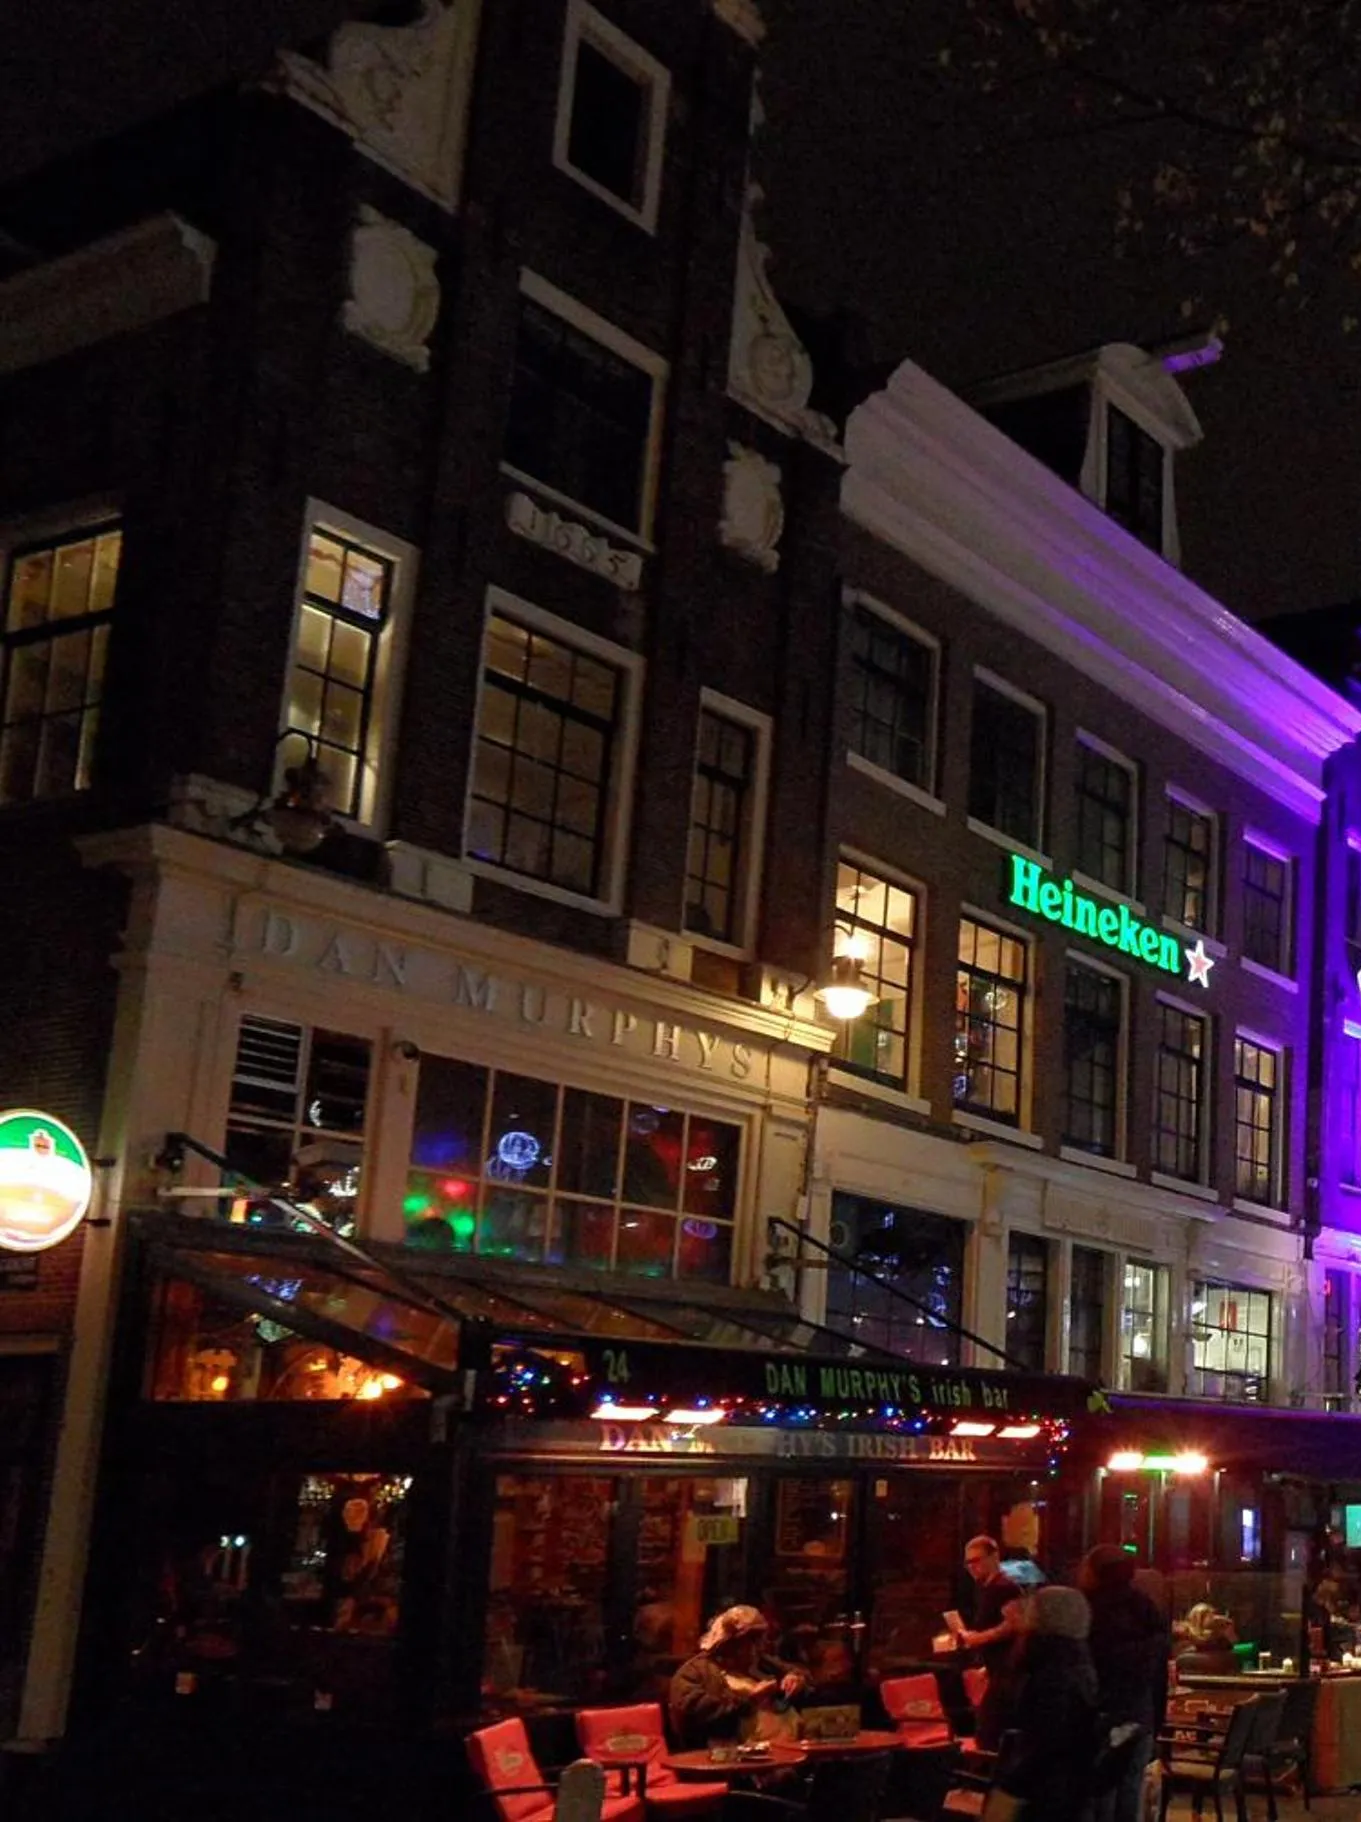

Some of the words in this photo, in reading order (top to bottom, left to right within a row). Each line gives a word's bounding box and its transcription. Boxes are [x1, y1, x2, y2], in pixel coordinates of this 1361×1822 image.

[1010, 854, 1181, 973] Heineken
[261, 906, 406, 985] DAN
[603, 1349, 632, 1383] 24
[766, 1364, 807, 1396] DAN
[821, 1368, 921, 1401] MURPHY'S
[932, 1378, 972, 1407] irish
[982, 1381, 1009, 1410] bar
[601, 1424, 673, 1452] DAN
[848, 1435, 917, 1459] IRISH
[930, 1436, 976, 1461] BAR
